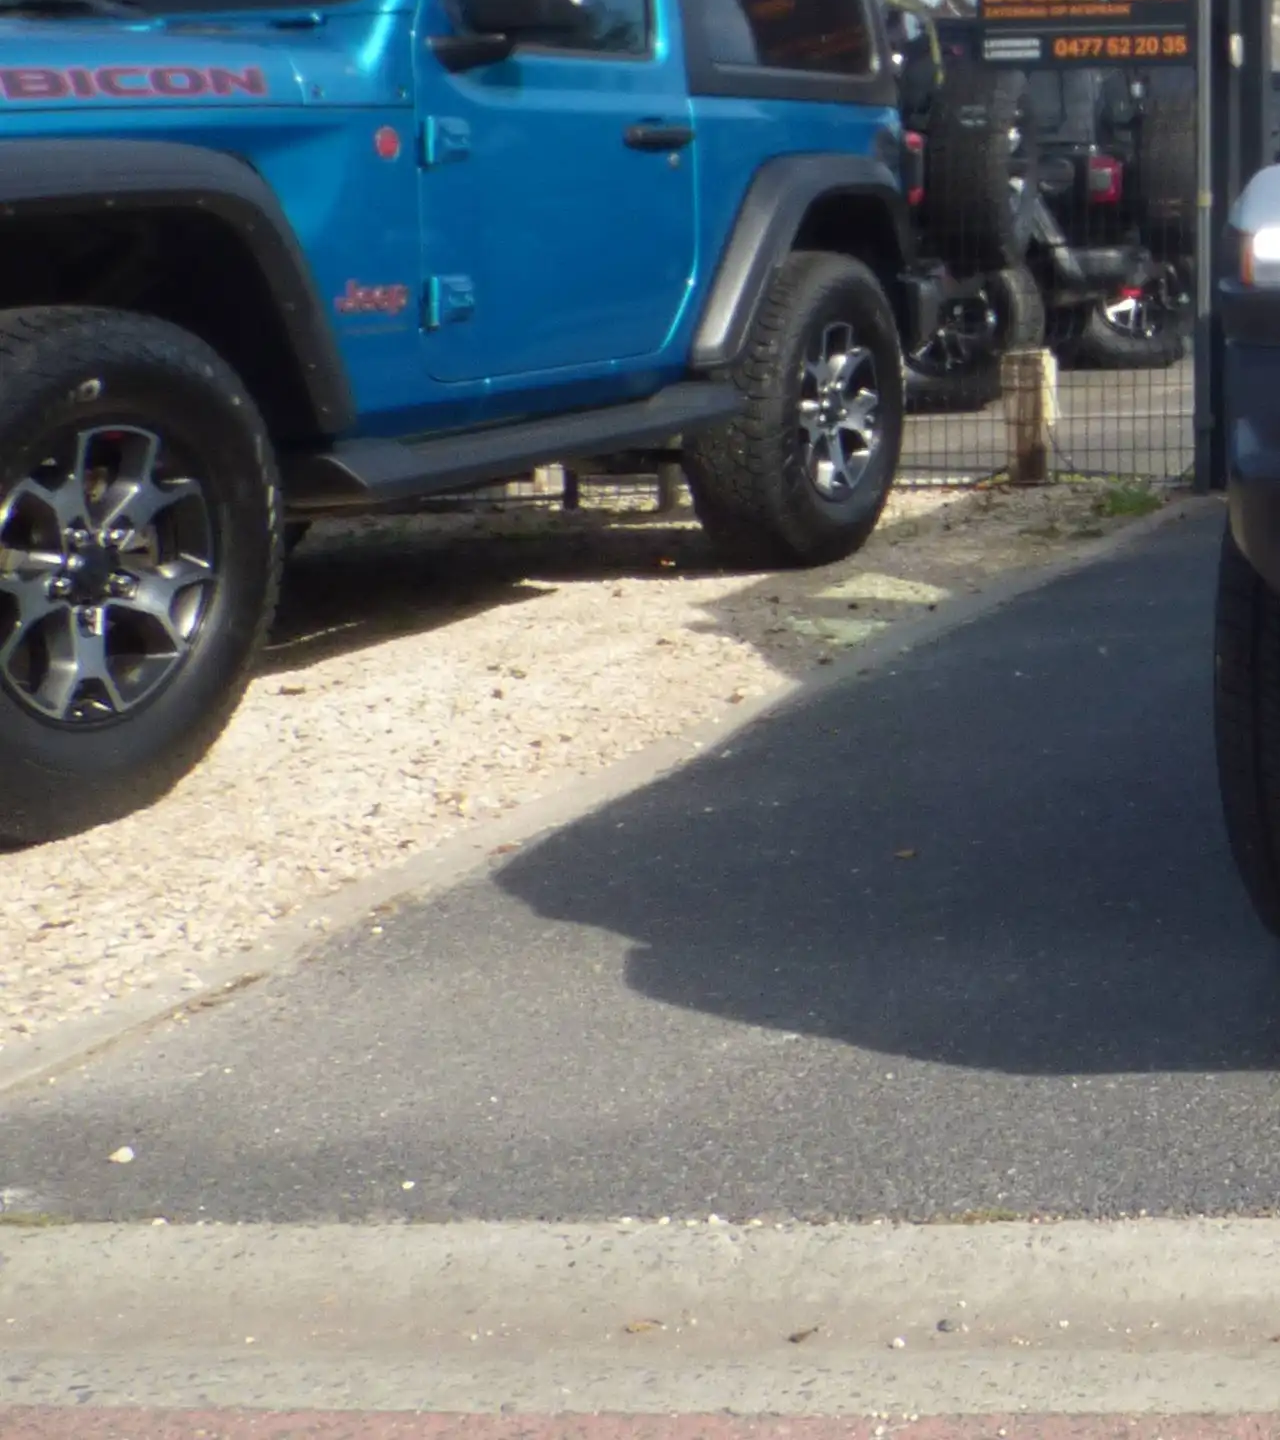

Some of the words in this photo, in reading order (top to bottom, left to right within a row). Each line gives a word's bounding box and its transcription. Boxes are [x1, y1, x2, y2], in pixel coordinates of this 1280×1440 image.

[1054, 38, 1104, 57] 0477
[1135, 36, 1159, 56] 20
[1162, 35, 1187, 55] 35
